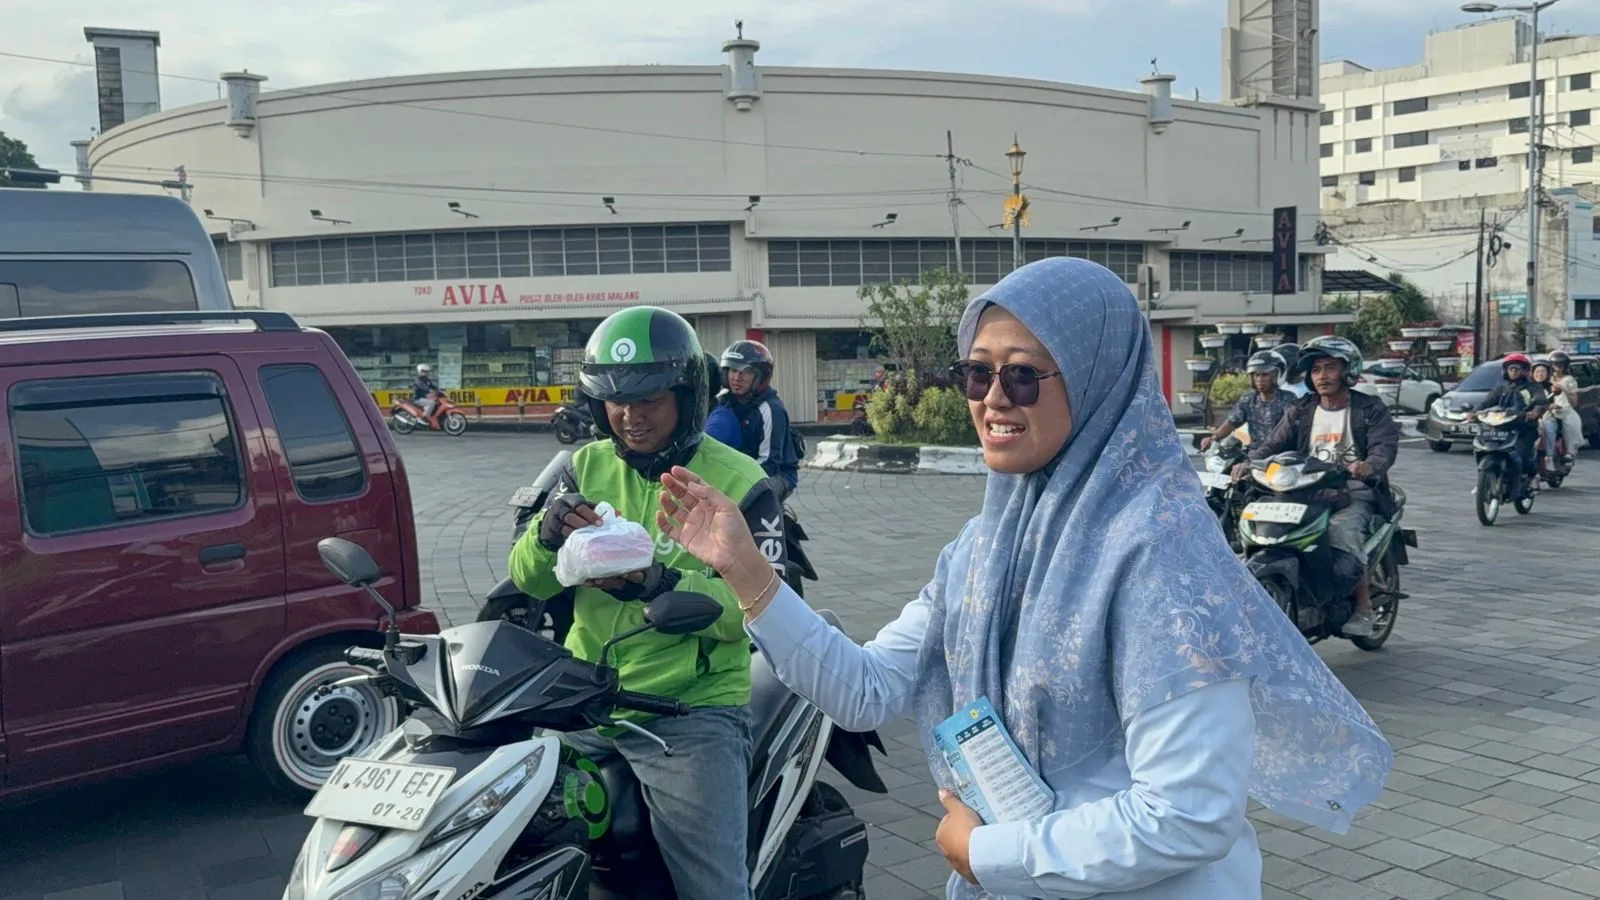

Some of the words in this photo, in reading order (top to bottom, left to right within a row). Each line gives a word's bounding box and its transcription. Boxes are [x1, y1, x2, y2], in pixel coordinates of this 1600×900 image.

[1277, 211, 1292, 290] AVIA
[414, 286, 432, 296] TOKO
[442, 283, 508, 306] AVIA
[544, 292, 584, 303] OLEH-OLEH
[586, 292, 606, 302] KHAS
[607, 290, 640, 301] MALANG
[505, 388, 551, 403] AVIA
[461, 664, 500, 677] HONDA
[329, 763, 350, 785] N
[354, 766, 402, 792] 4961
